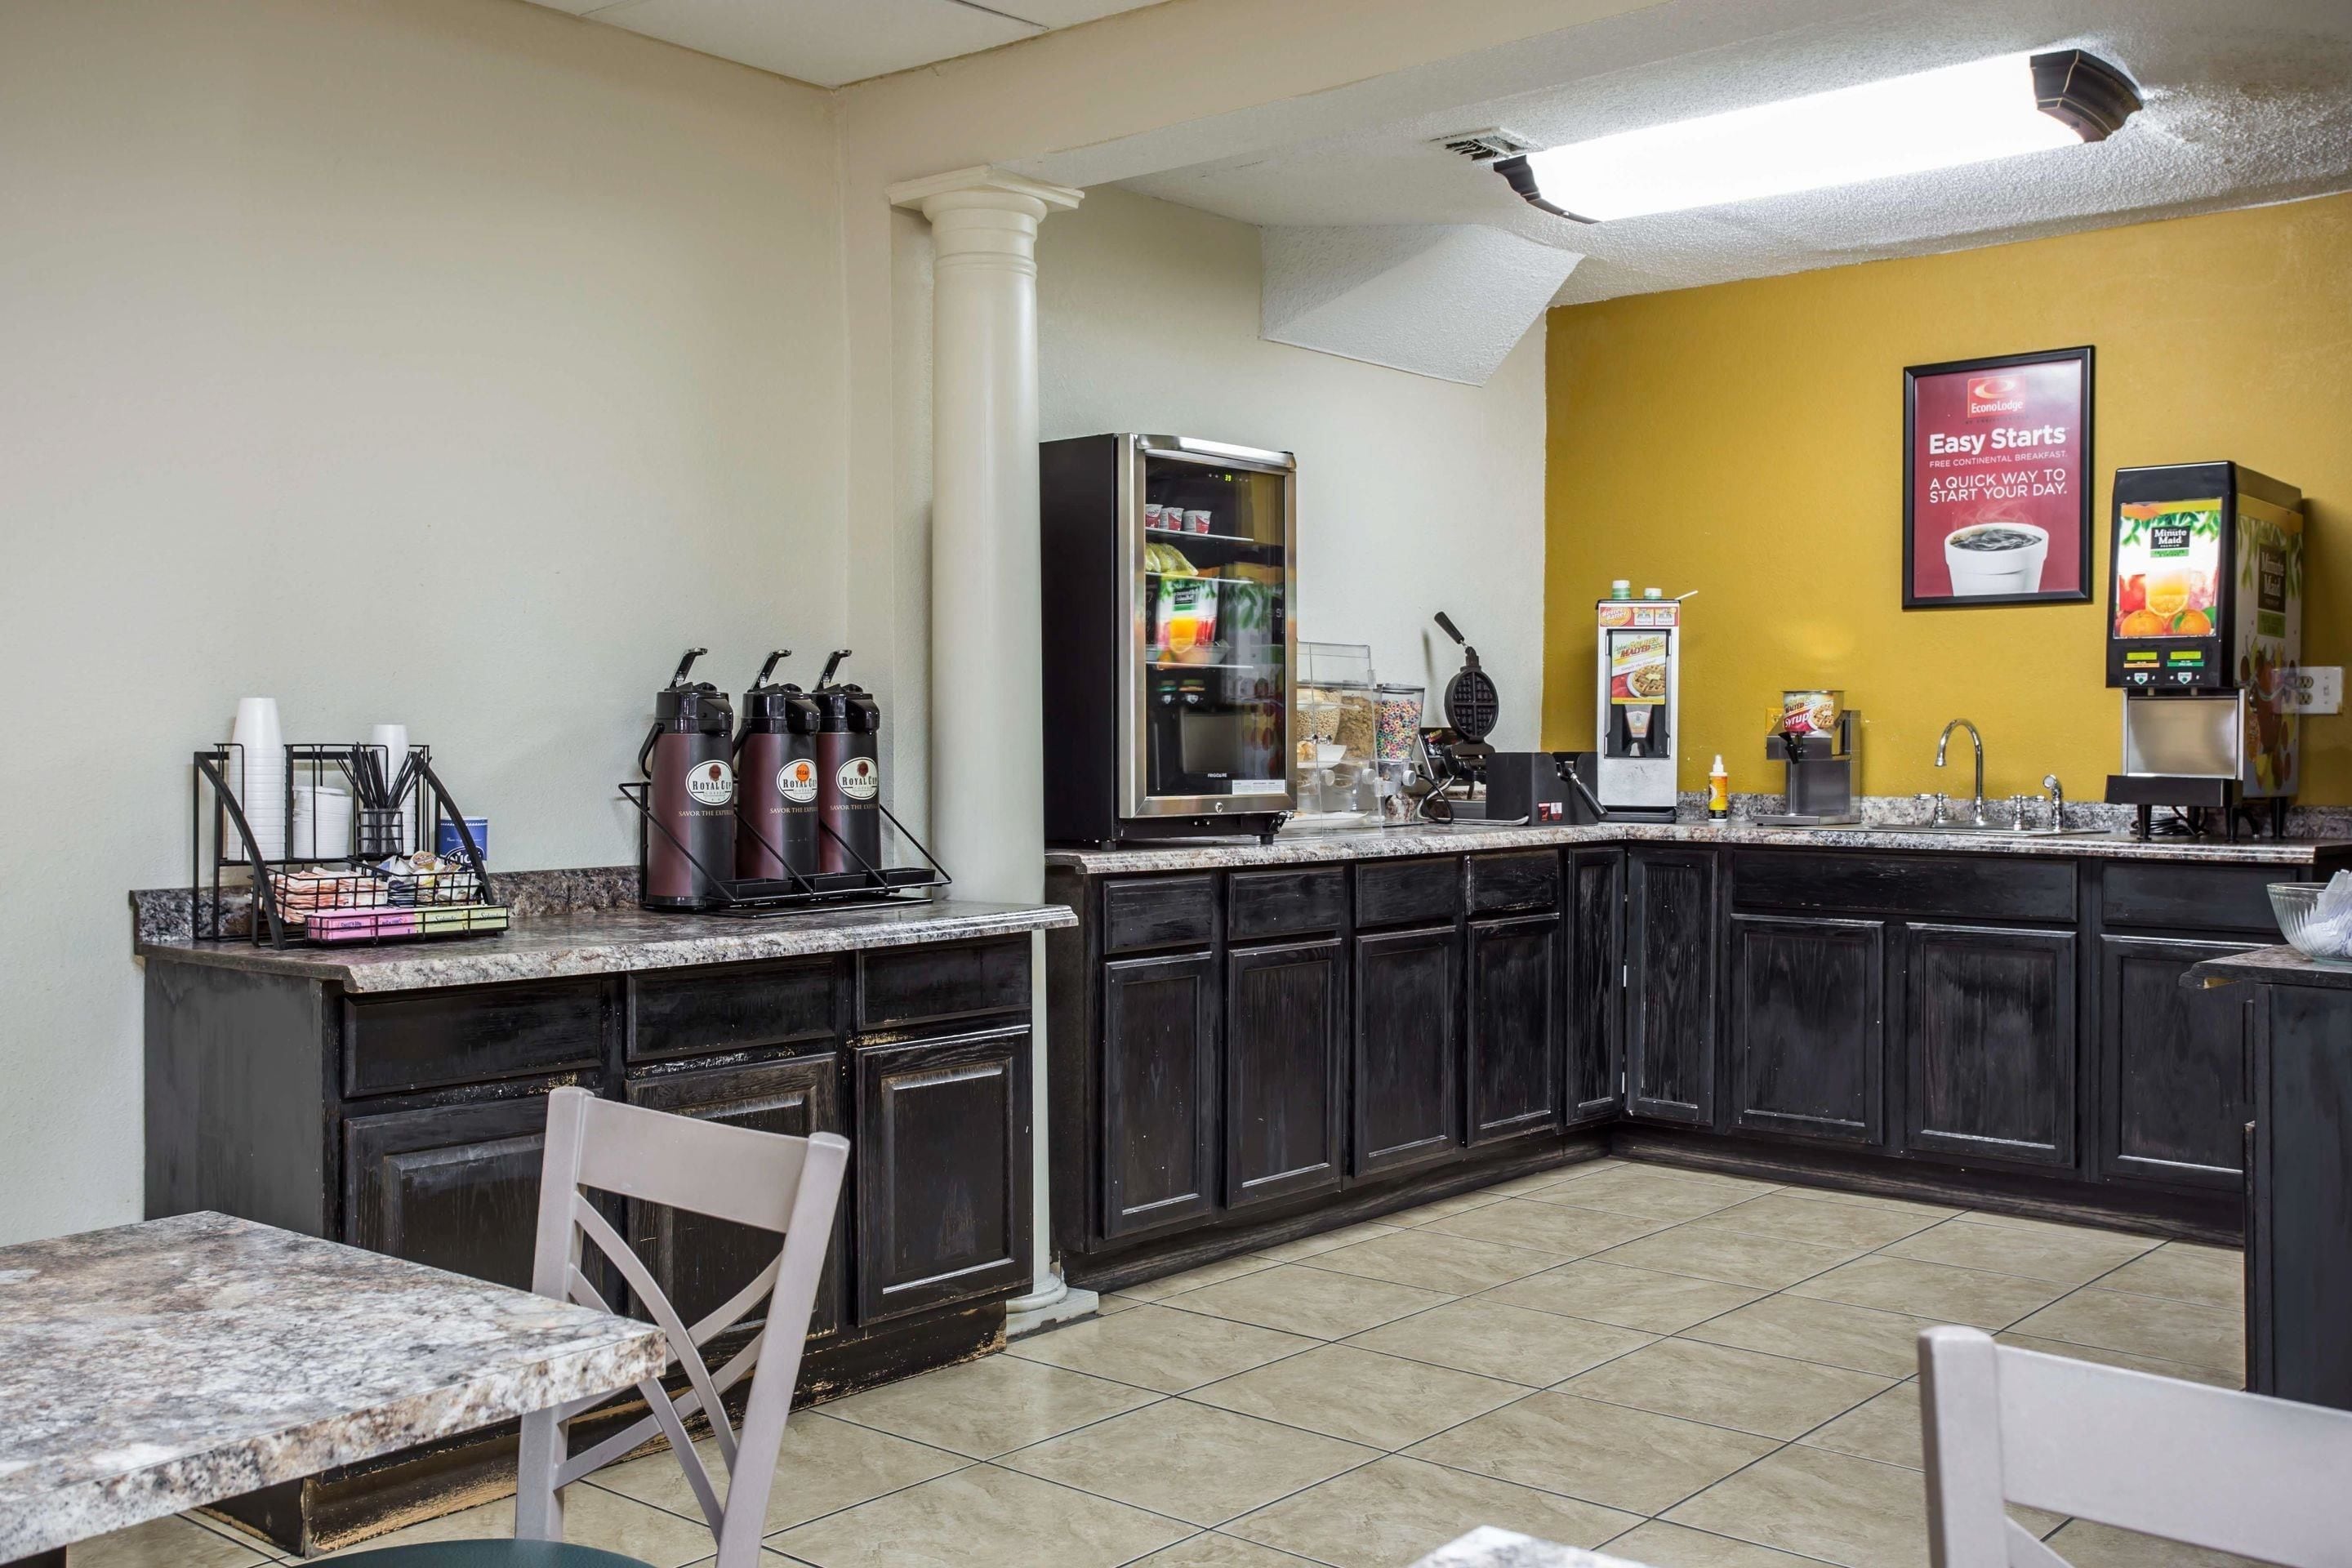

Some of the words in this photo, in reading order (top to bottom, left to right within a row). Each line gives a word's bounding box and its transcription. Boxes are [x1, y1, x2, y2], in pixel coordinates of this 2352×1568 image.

[1971, 400, 2024, 414] EconoLodge
[1929, 433, 1986, 455] Easy
[1991, 424, 2066, 449] Starts
[1929, 460, 1951, 468] FREE
[1953, 455, 2012, 466] CONTINENTAL
[2015, 450, 2068, 461] BREAKFAST.
[1929, 478, 1941, 491] A
[1945, 473, 1997, 489] QUICK
[2002, 470, 2038, 485] WAY
[2044, 468, 2066, 482] TO
[1929, 488, 1978, 504] START
[1983, 485, 2028, 500] YOUR
[2033, 482, 2068, 497] DAY.
[2154, 528, 2187, 538] Minute
[2158, 536, 2182, 545] Maid
[1620, 644, 1651, 658] MALTED
[1785, 712, 1810, 728] Syrup
[693, 781, 719, 791] ROYAL
[783, 778, 808, 788] ROYAL
[842, 777, 866, 786] ROYAL
